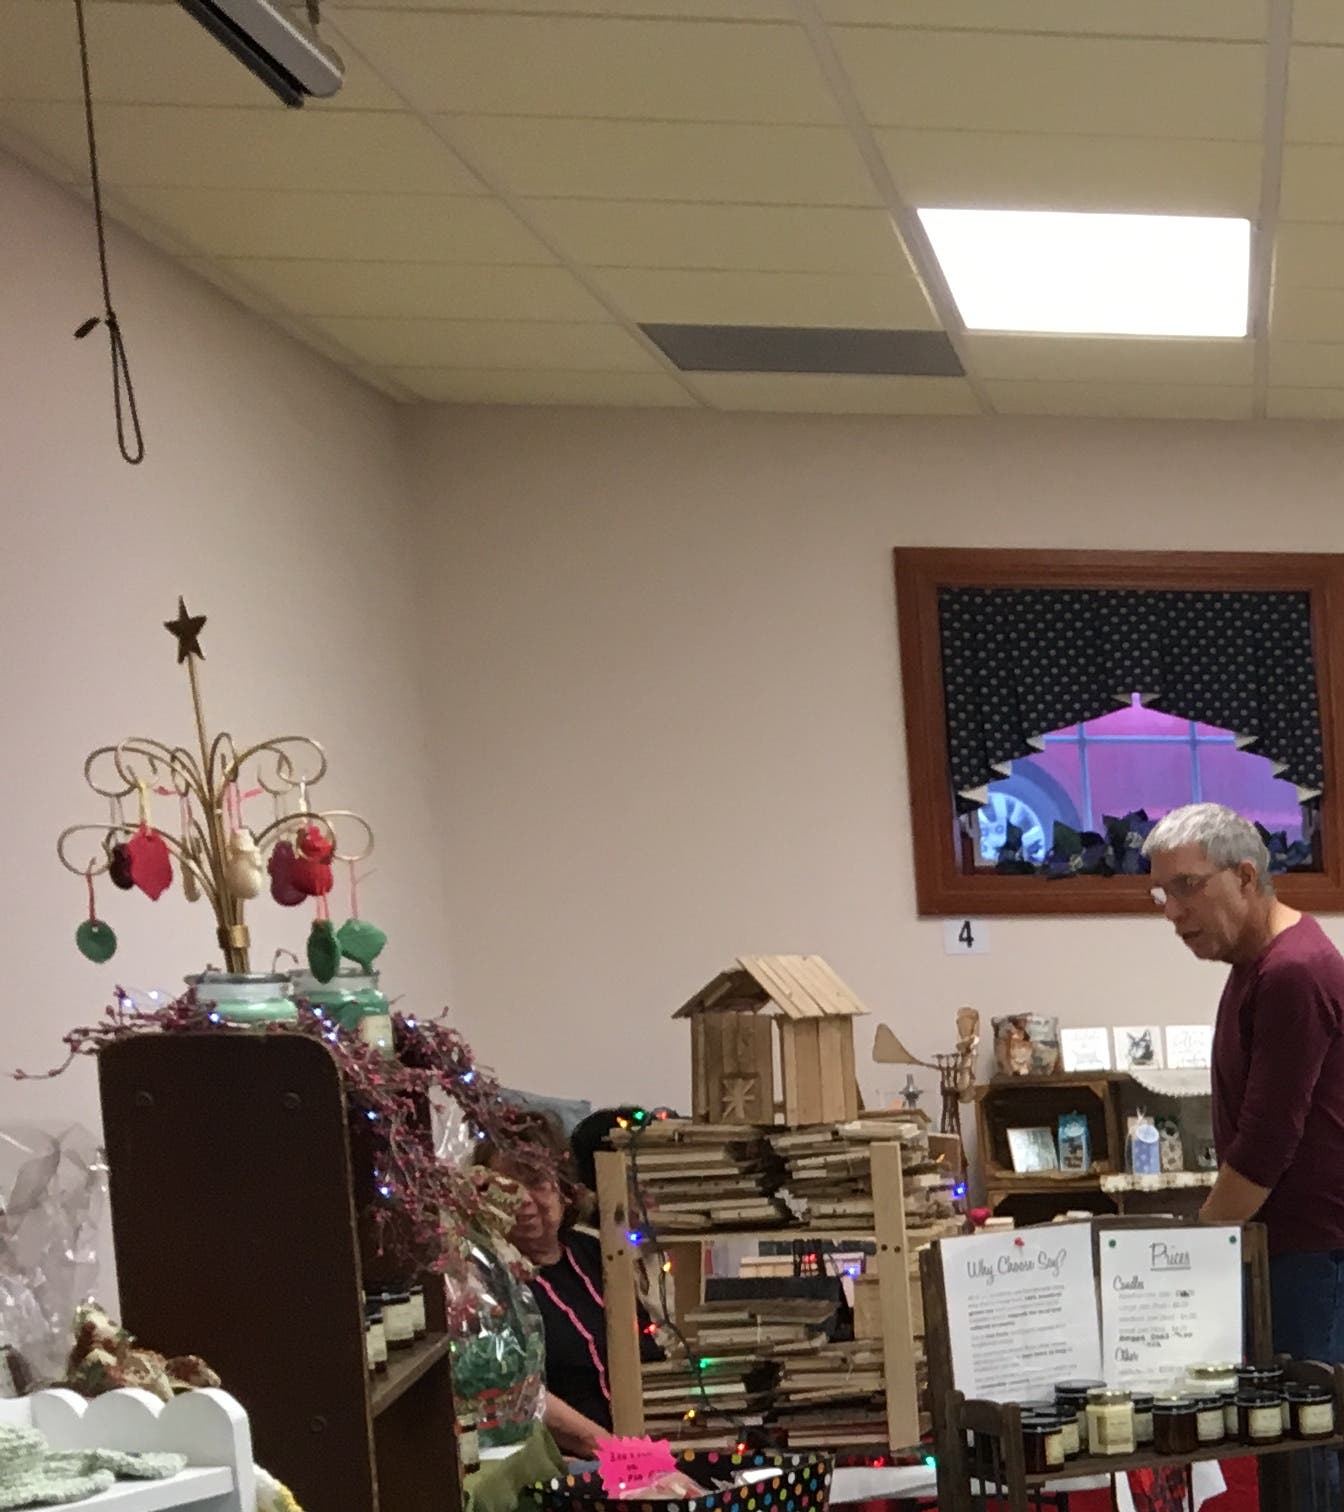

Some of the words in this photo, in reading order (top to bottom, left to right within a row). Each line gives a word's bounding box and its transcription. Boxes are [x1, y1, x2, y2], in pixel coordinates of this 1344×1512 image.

[958, 920, 975, 948] 4
[1149, 1243, 1191, 1267] Prices
[966, 1258, 995, 1286] Why
